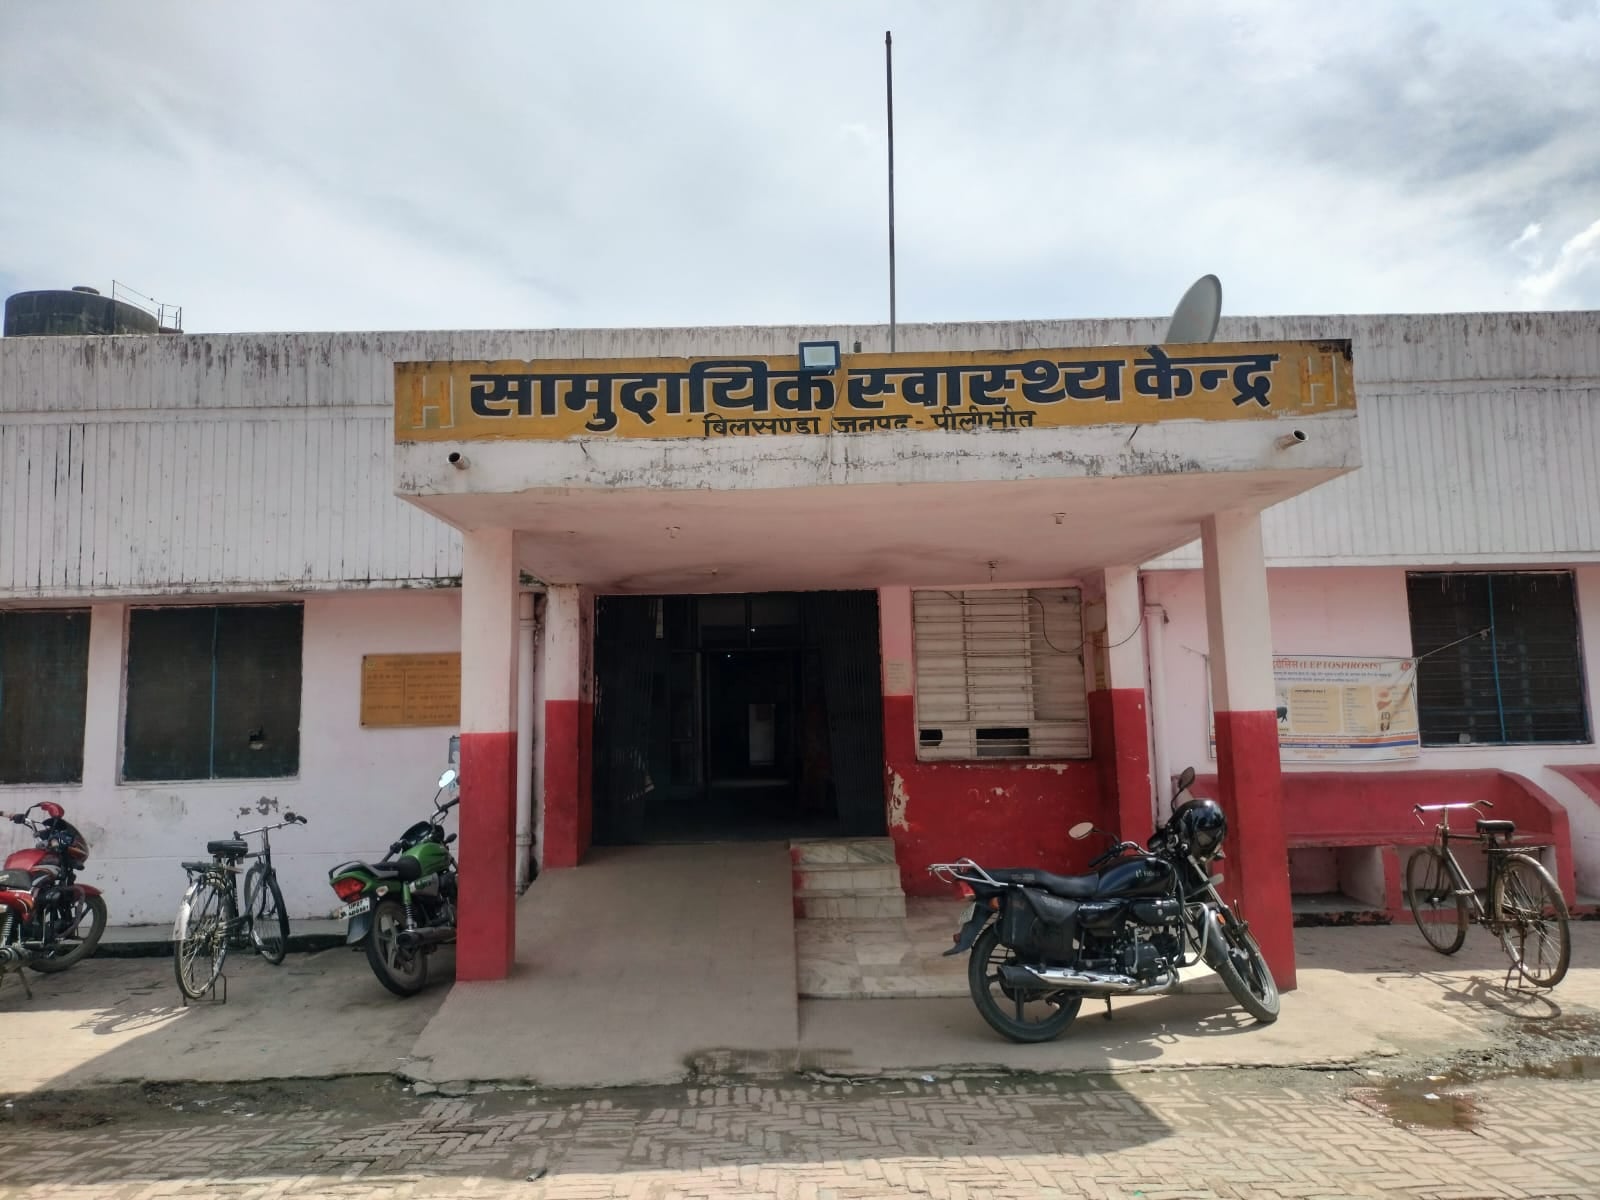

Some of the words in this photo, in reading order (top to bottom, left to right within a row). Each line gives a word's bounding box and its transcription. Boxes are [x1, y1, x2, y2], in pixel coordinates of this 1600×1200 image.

[470, 360, 834, 432] सामुदायिक
[847, 359, 1126, 409] स्वास्थ्य
[1133, 345, 1280, 408] केन्द्र
[702, 412, 822, 437] बिलसण्डा
